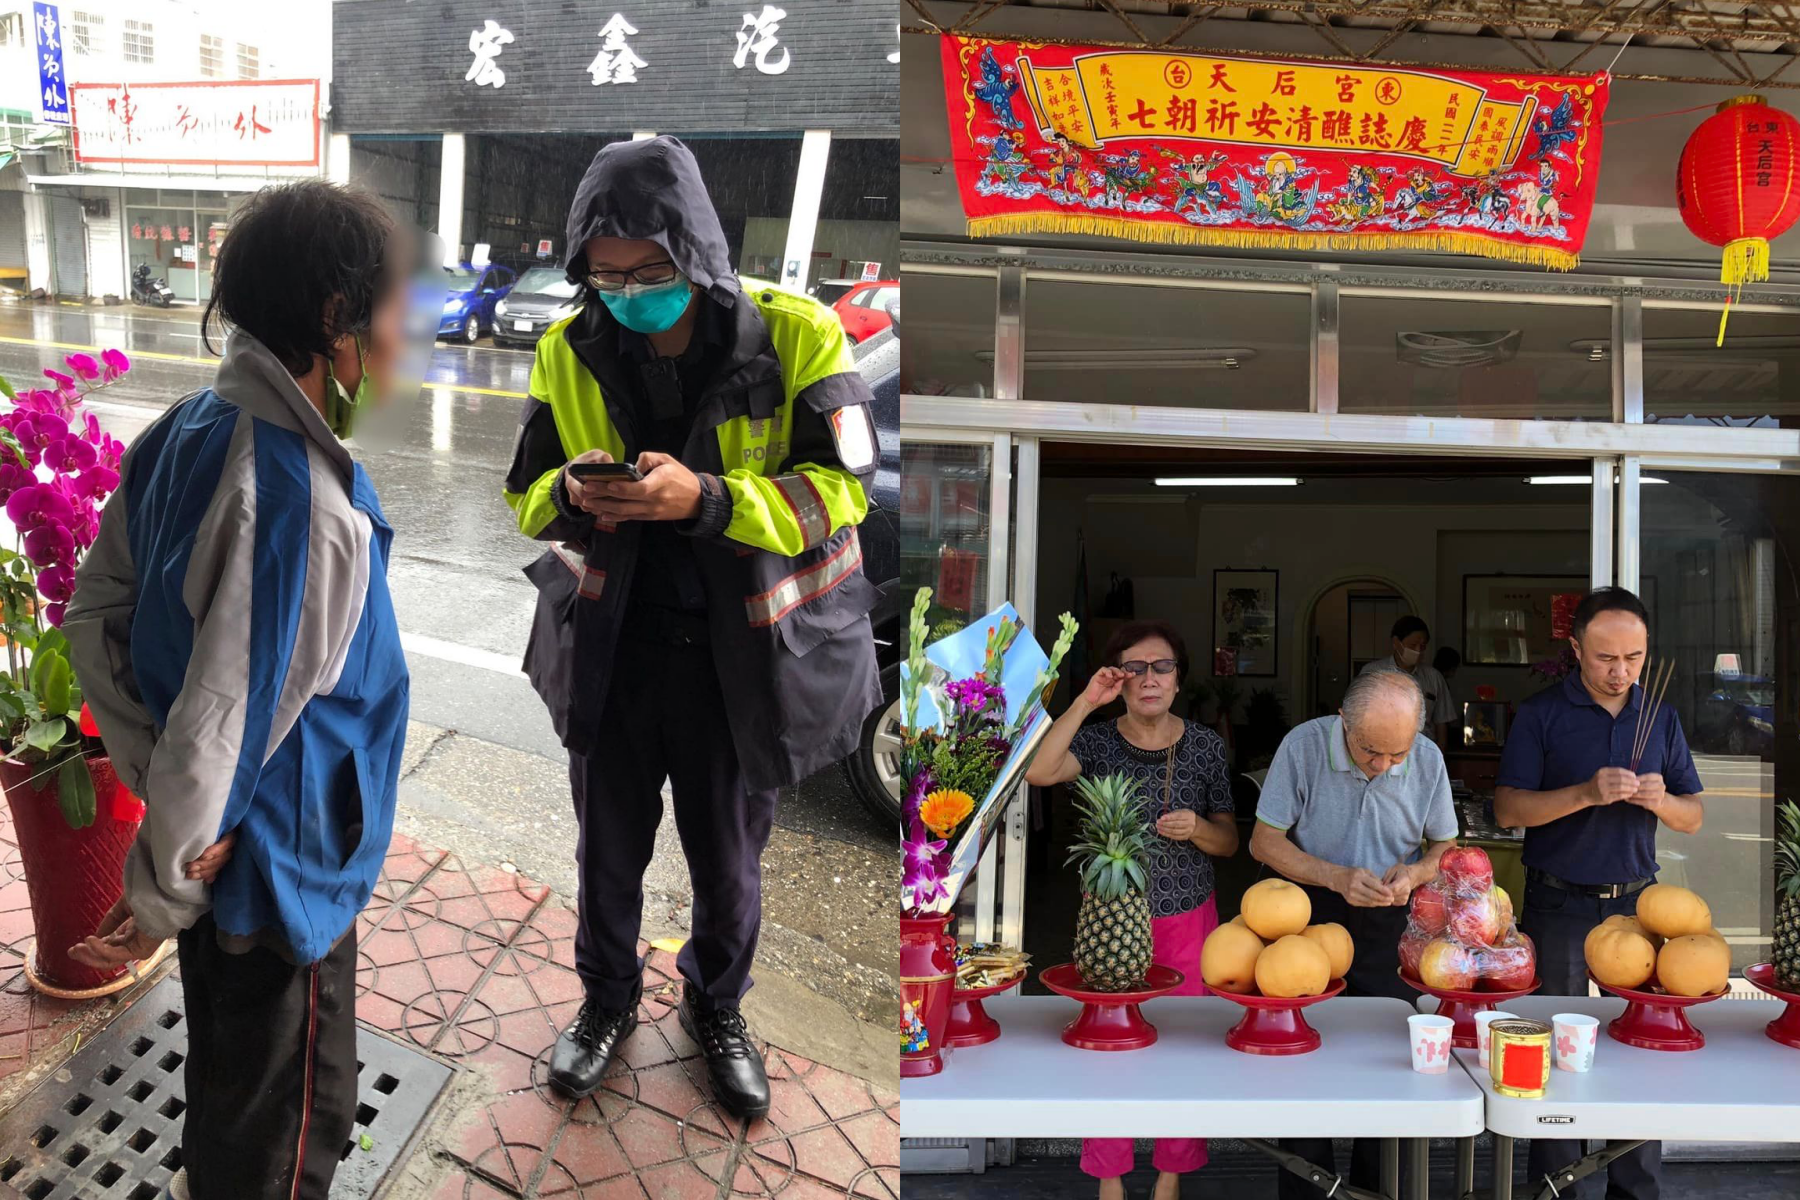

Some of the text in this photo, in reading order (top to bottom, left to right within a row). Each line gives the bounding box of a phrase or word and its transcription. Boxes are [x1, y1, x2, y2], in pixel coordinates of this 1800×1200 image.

[465, 4, 900, 89] 宏鑫汽
[1059, 73, 1084, 133] 合境平安
[1099, 63, 1121, 130] 歲次壬寅年
[1128, 94, 1431, 154] 七朝祈安清醮誌慶
[1468, 107, 1494, 161] 國泰民安
[1482, 117, 1508, 167] 風調雨順
[1757, 140, 1774, 187] 天后宮
